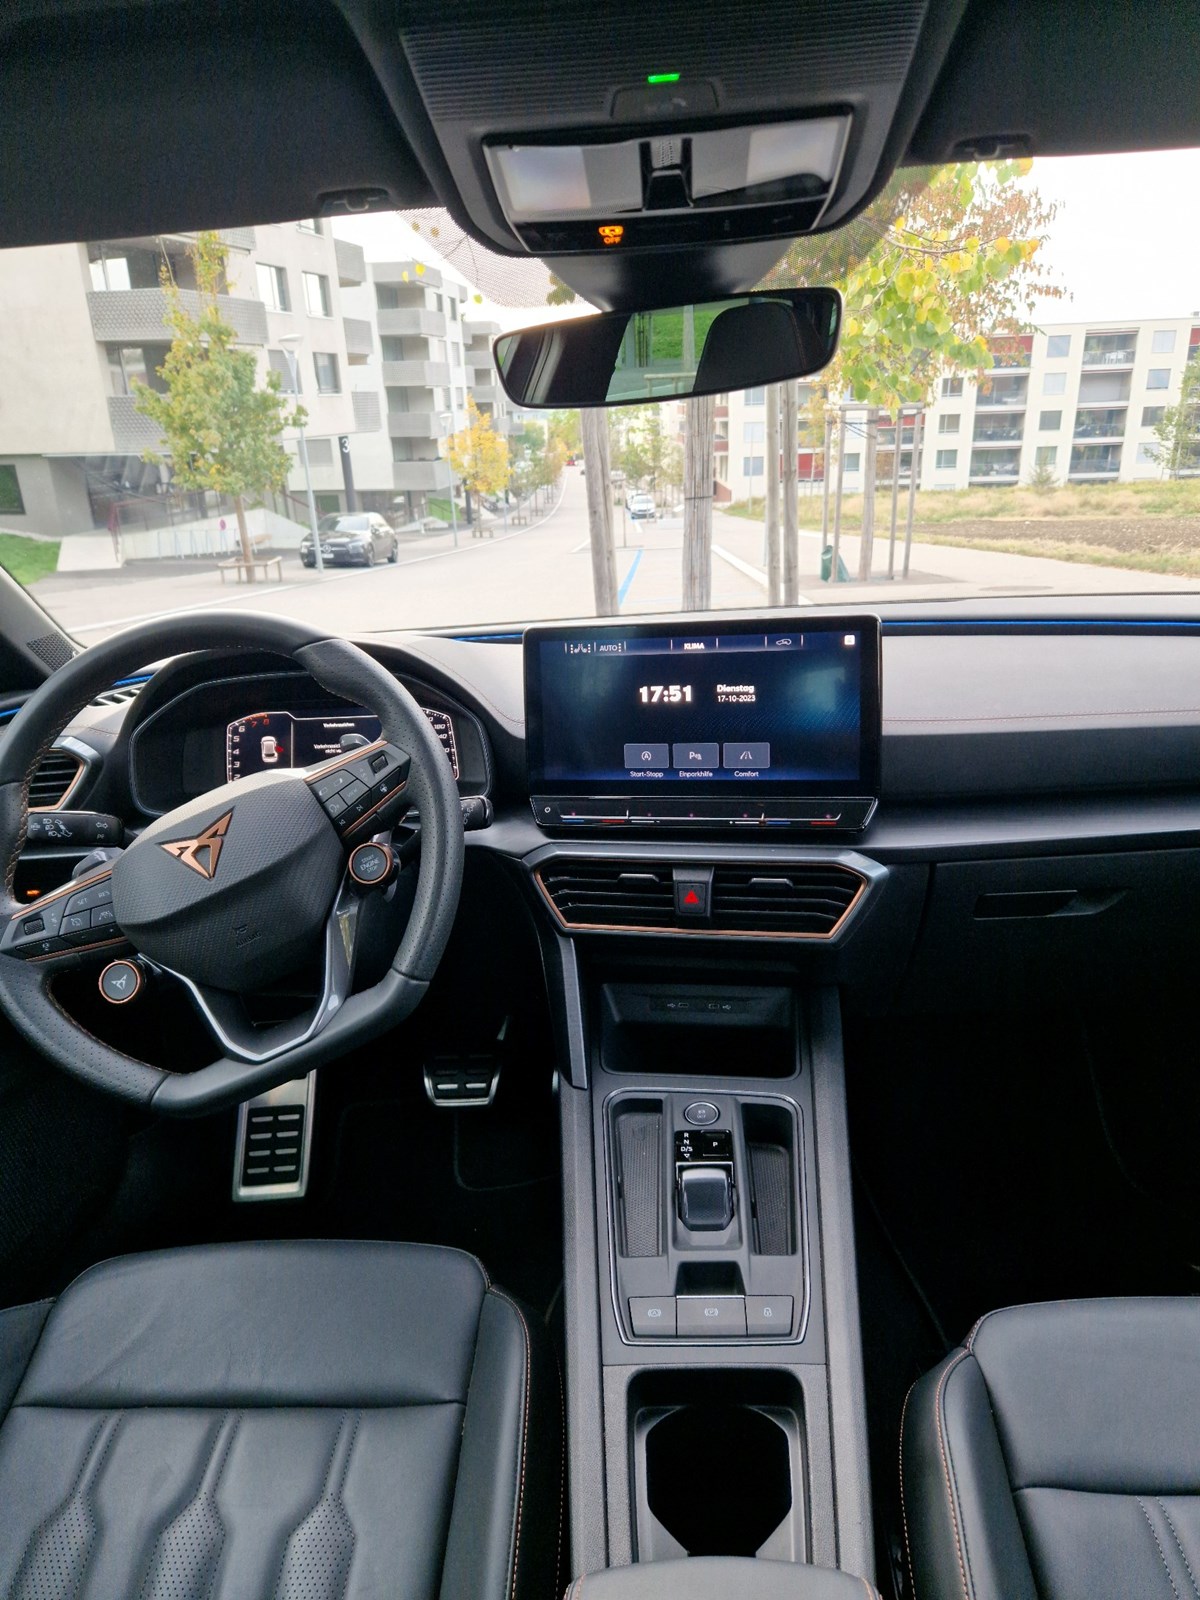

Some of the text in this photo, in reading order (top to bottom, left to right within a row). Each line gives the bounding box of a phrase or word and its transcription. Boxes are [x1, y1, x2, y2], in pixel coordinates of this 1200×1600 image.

[603, 236, 621, 244] OFF
[341, 437, 350, 453] 3
[599, 644, 618, 652] AUTO
[683, 642, 705, 650] KLIMA
[716, 684, 755, 694] Dienstag
[639, 684, 692, 703] 17:51
[717, 694, 756, 702] 17-10-2023
[238, 725, 246, 733] 6
[233, 735, 240, 743] 5
[629, 770, 664, 778] Start-Stopp
